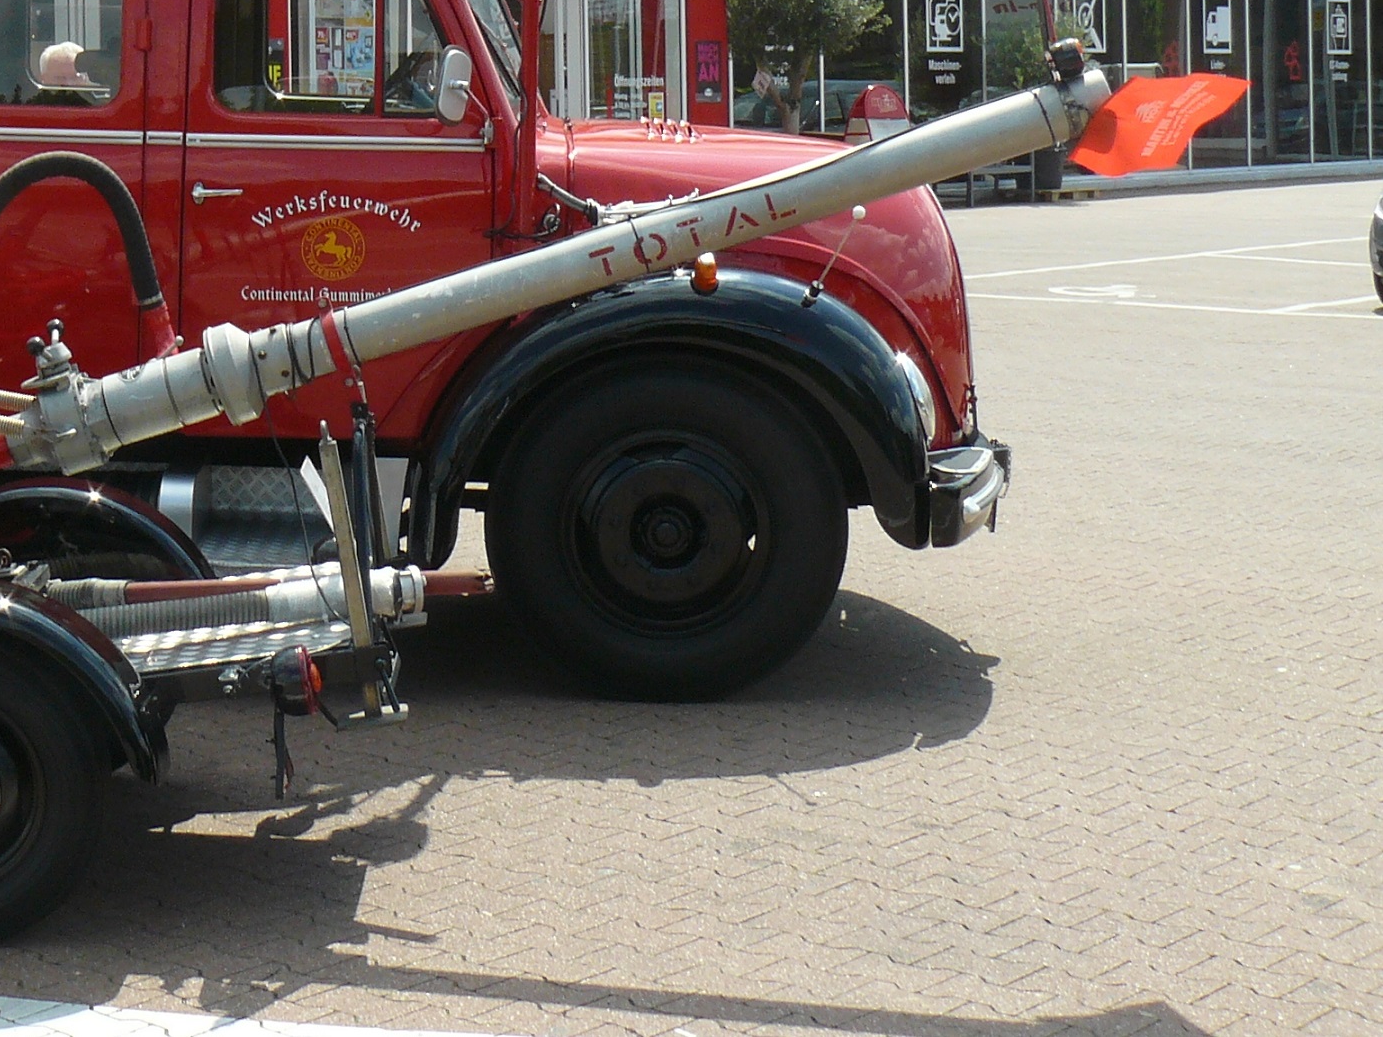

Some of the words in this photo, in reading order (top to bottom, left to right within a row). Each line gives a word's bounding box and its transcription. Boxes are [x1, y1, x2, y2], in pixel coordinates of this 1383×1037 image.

[251, 190, 421, 232] Werksfeuerwehr
[589, 194, 796, 276] TOTAL
[241, 285, 314, 302] Continental
